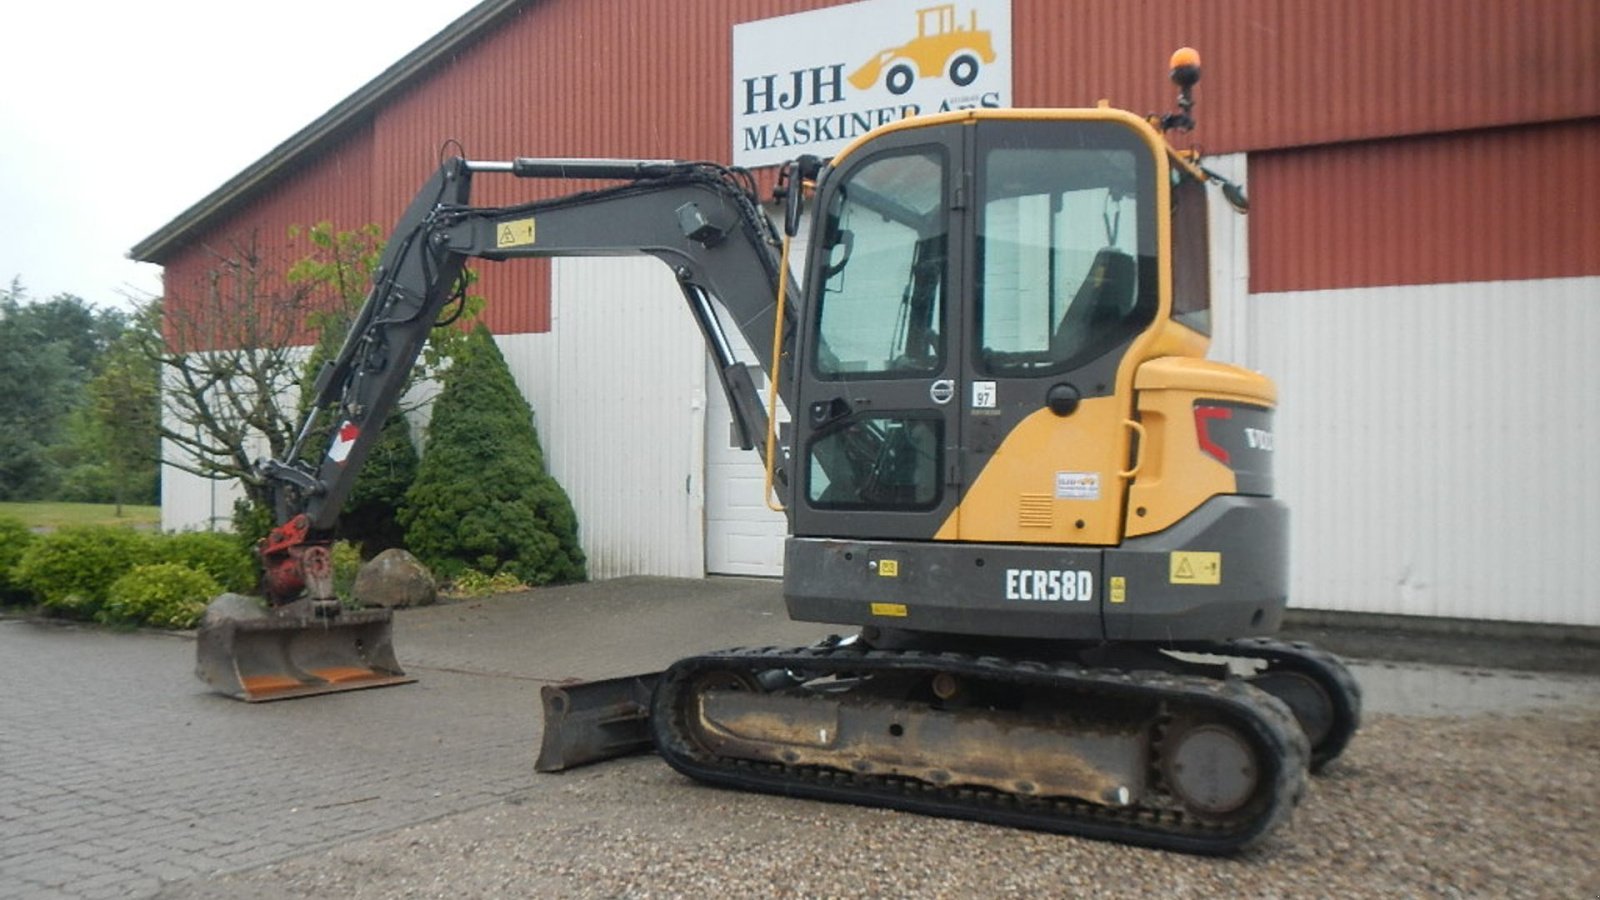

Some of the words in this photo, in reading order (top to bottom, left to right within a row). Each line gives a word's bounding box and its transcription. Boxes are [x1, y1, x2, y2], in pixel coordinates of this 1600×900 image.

[743, 63, 846, 115] HJH
[977, 392, 991, 406] 97
[1006, 569, 1093, 601] ECR58D
